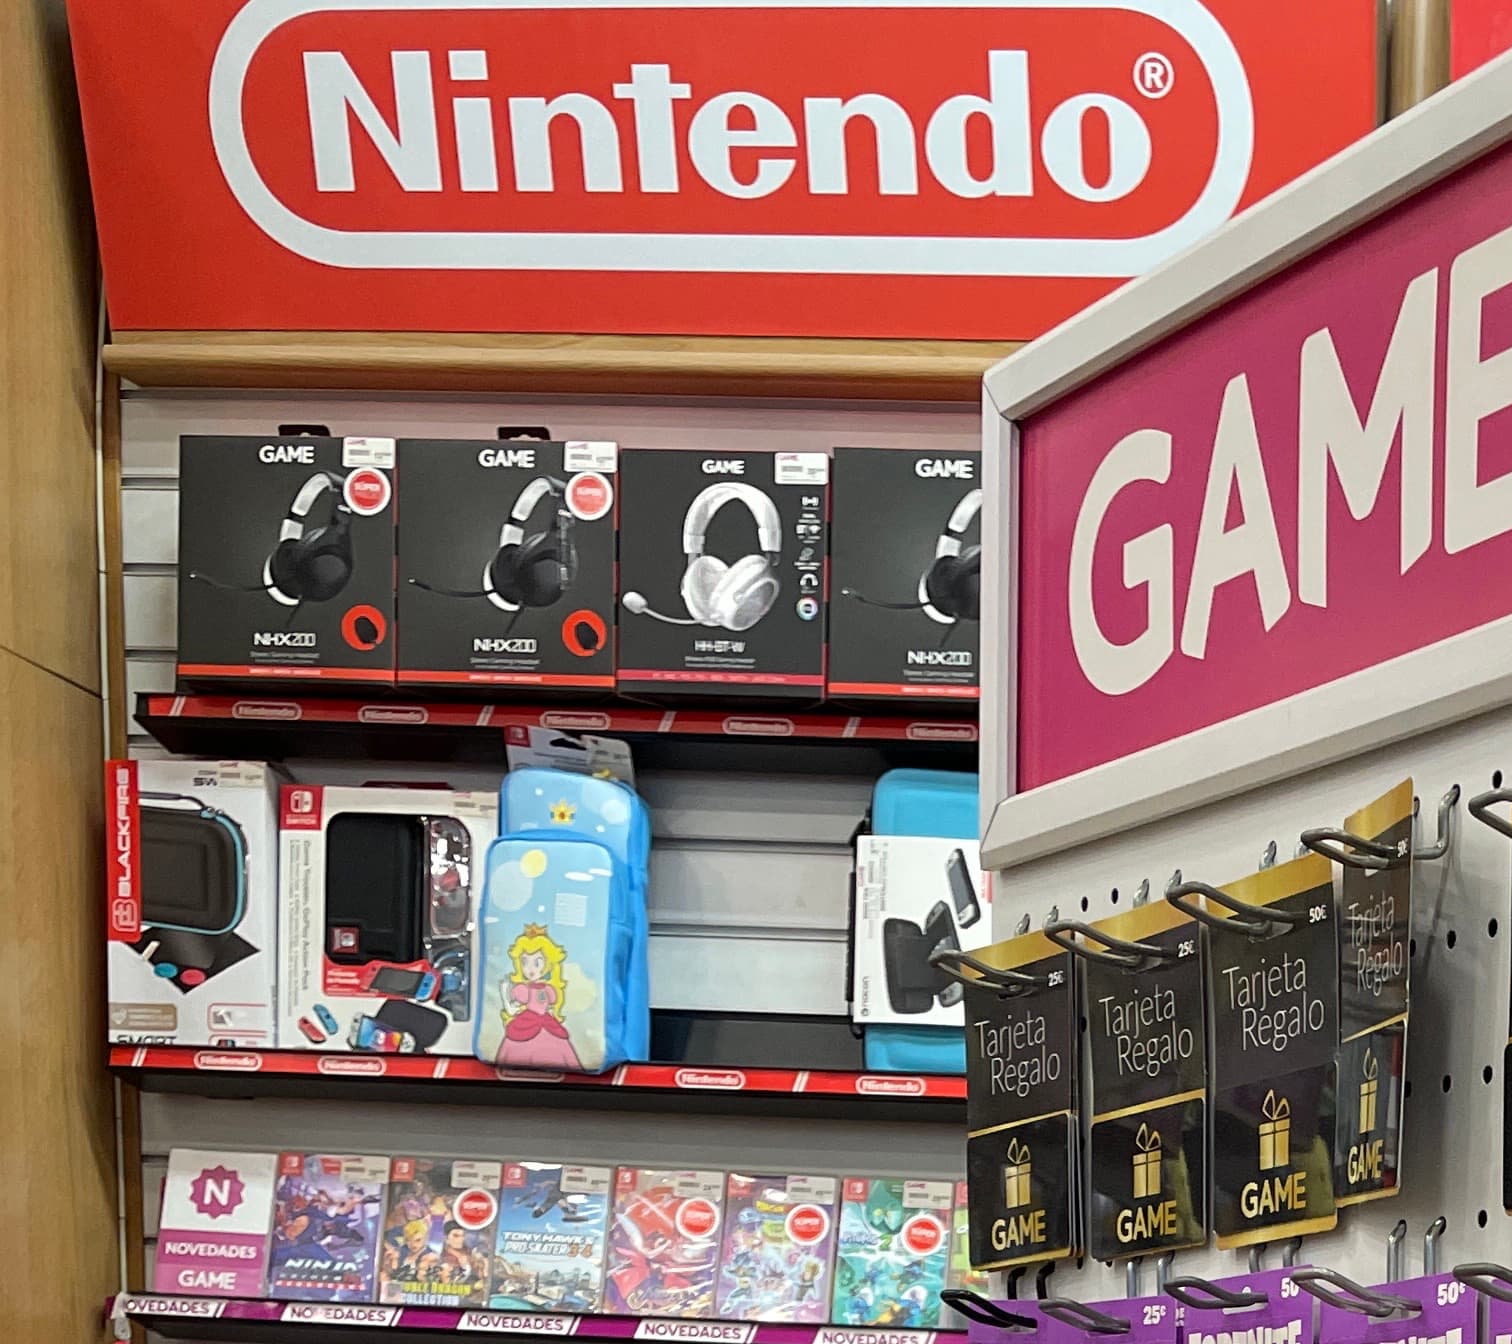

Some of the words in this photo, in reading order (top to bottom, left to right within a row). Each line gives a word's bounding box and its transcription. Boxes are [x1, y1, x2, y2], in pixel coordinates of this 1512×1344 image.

[259, 444, 315, 464] GAME
[478, 448, 535, 469] GAME
[702, 458, 745, 475] GAME
[915, 458, 974, 480] GAME
[113, 767, 132, 898] BLACKFIRE
[1309, 904, 1327, 923] 50€
[1177, 940, 1196, 958] 25€
[1356, 939, 1402, 997] Regalo
[1222, 955, 1307, 1012] Tarjeta
[1099, 987, 1176, 1038] Tarjeta
[1242, 996, 1325, 1052] Regalo
[974, 1011, 1046, 1059] Tarjeta
[1117, 1026, 1194, 1077] Regalo
[991, 1051, 1061, 1098] Regalo
[1347, 1141, 1383, 1184] GAME
[1241, 1171, 1307, 1219] GAME
[991, 1210, 1046, 1250] GAME
[1117, 1200, 1177, 1243] GAME
[165, 1243, 256, 1259] NOVEDADES
[178, 1271, 235, 1288] GAME
[291, 1307, 386, 1323] NOEDADES
[467, 1315, 563, 1331] NOVEDADES
[644, 1324, 741, 1340] NOVEDADES
